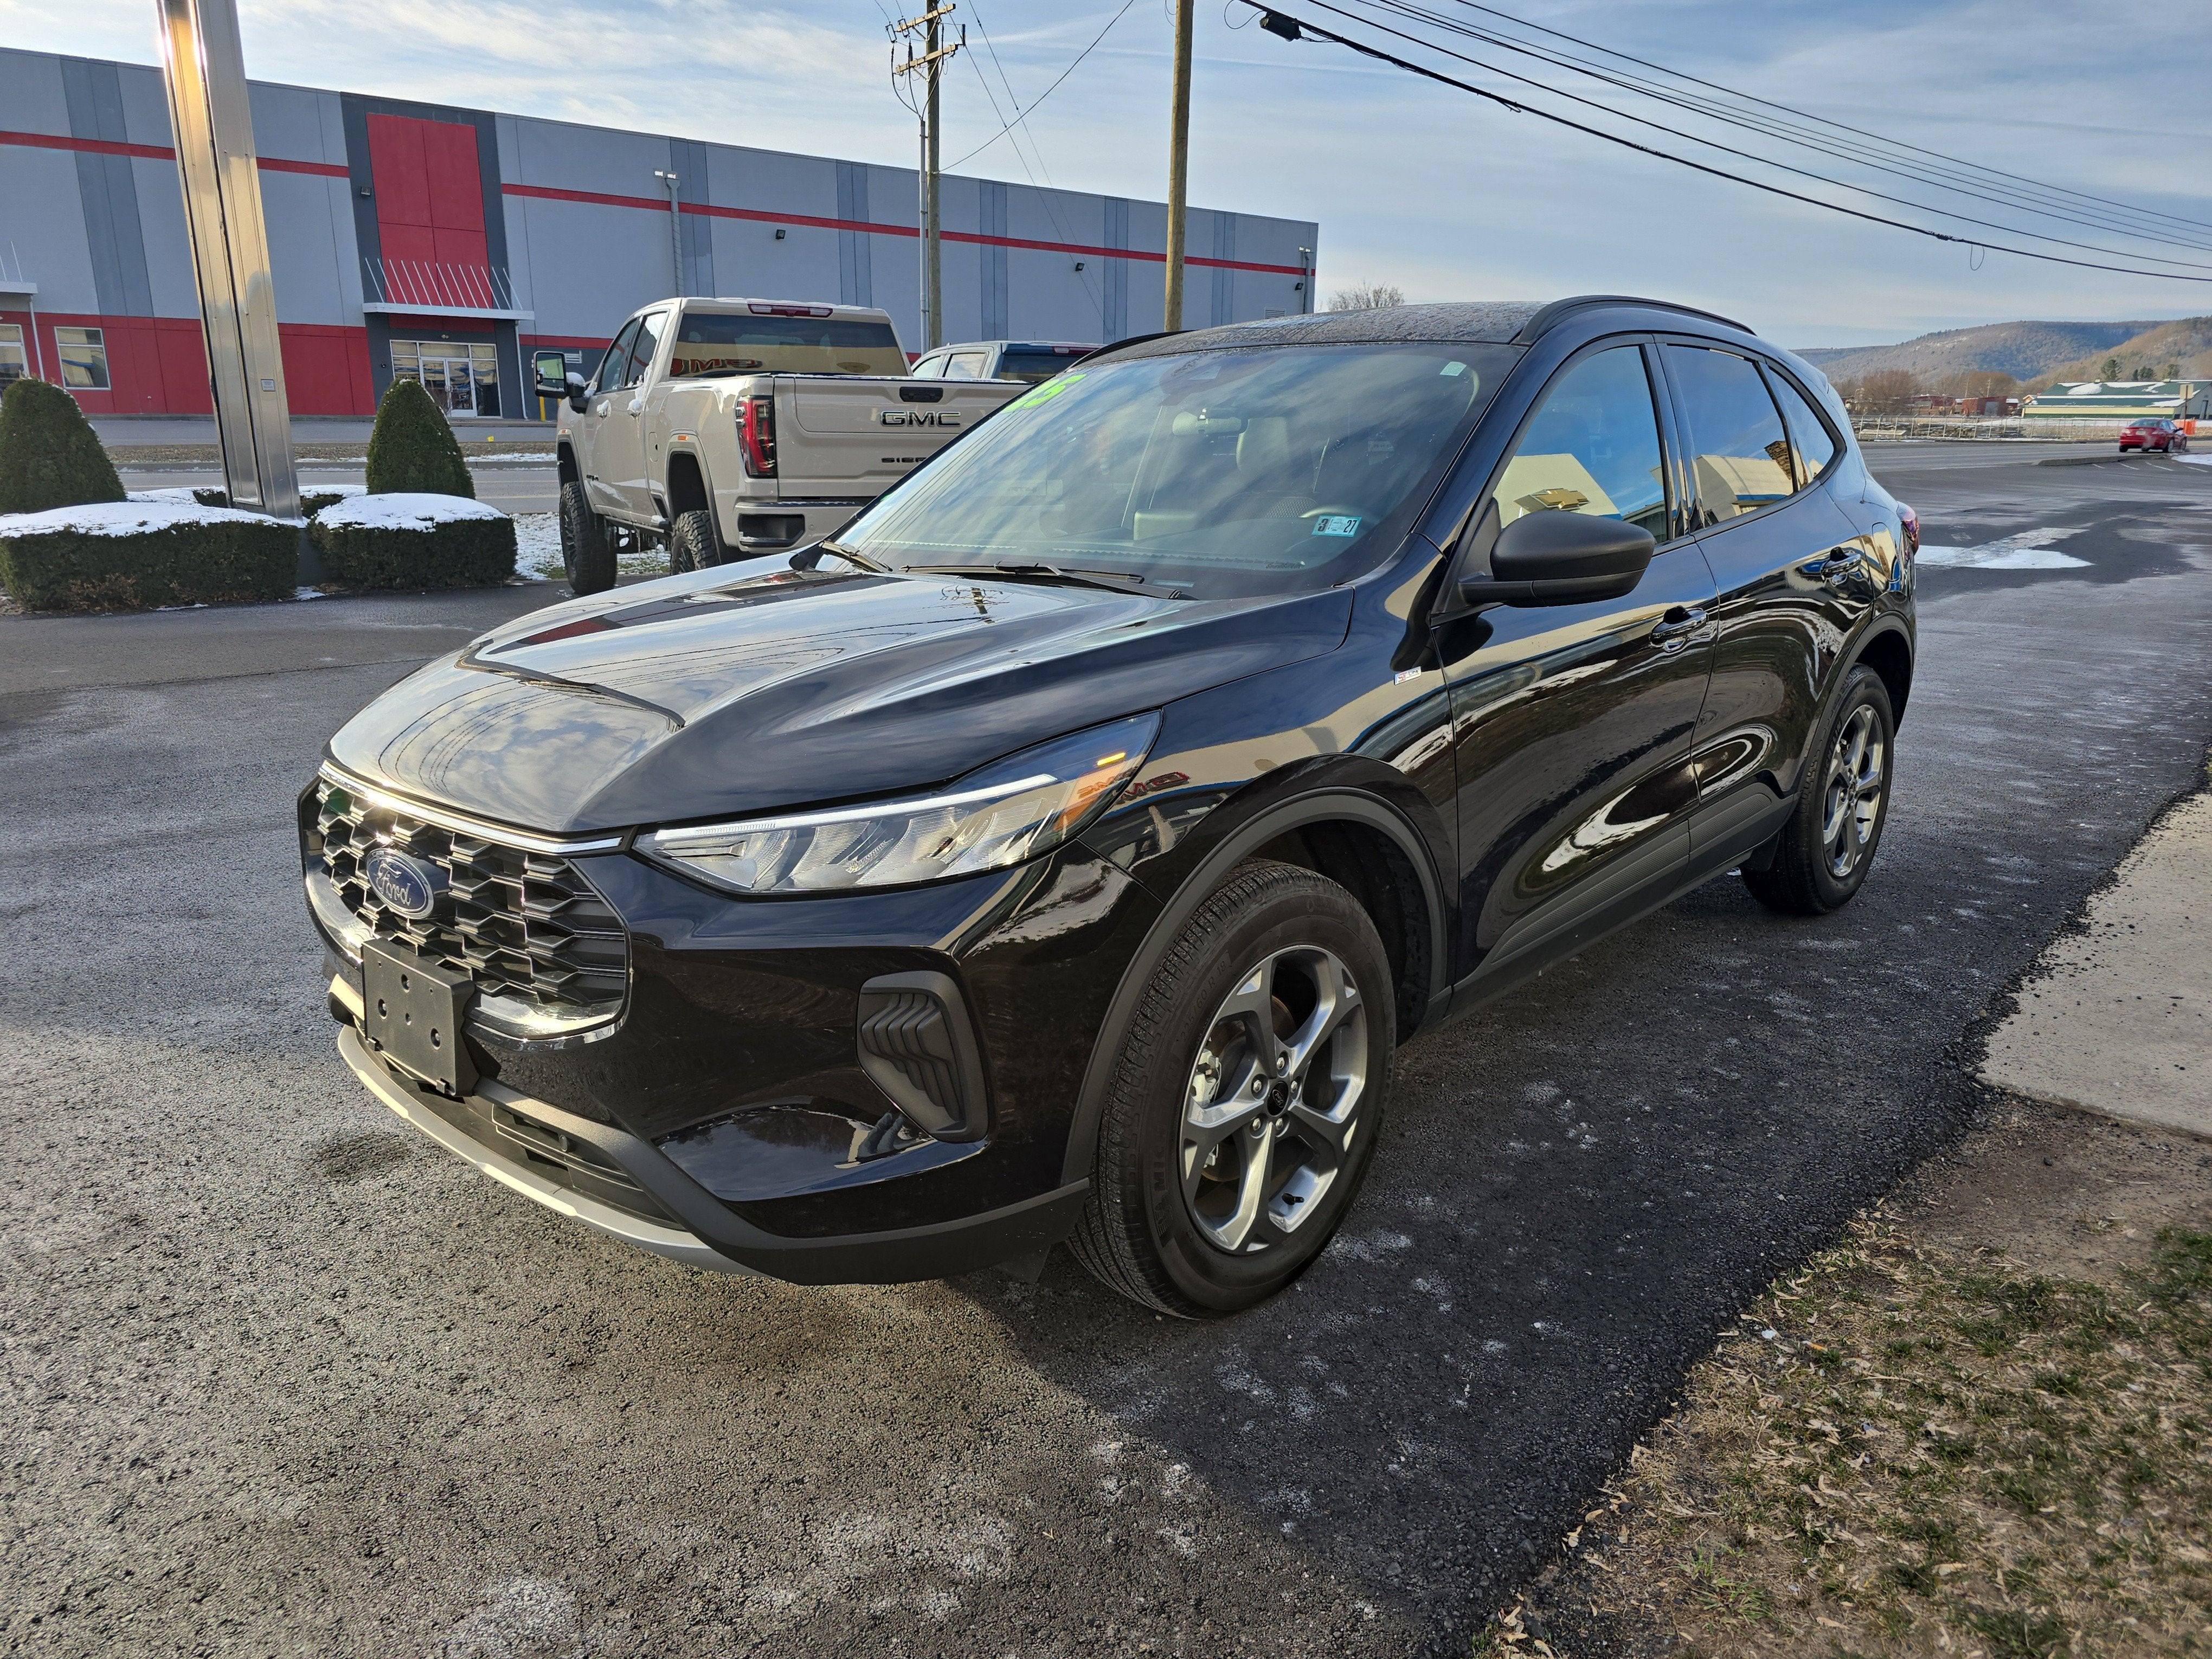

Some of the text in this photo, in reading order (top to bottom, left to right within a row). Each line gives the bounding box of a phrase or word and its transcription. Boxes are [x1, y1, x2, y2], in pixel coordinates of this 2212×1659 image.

[880, 410, 961, 427] GMC
[1317, 518, 1329, 532] 3
[1343, 519, 1358, 534] 27
[376, 862, 411, 906] Ford
